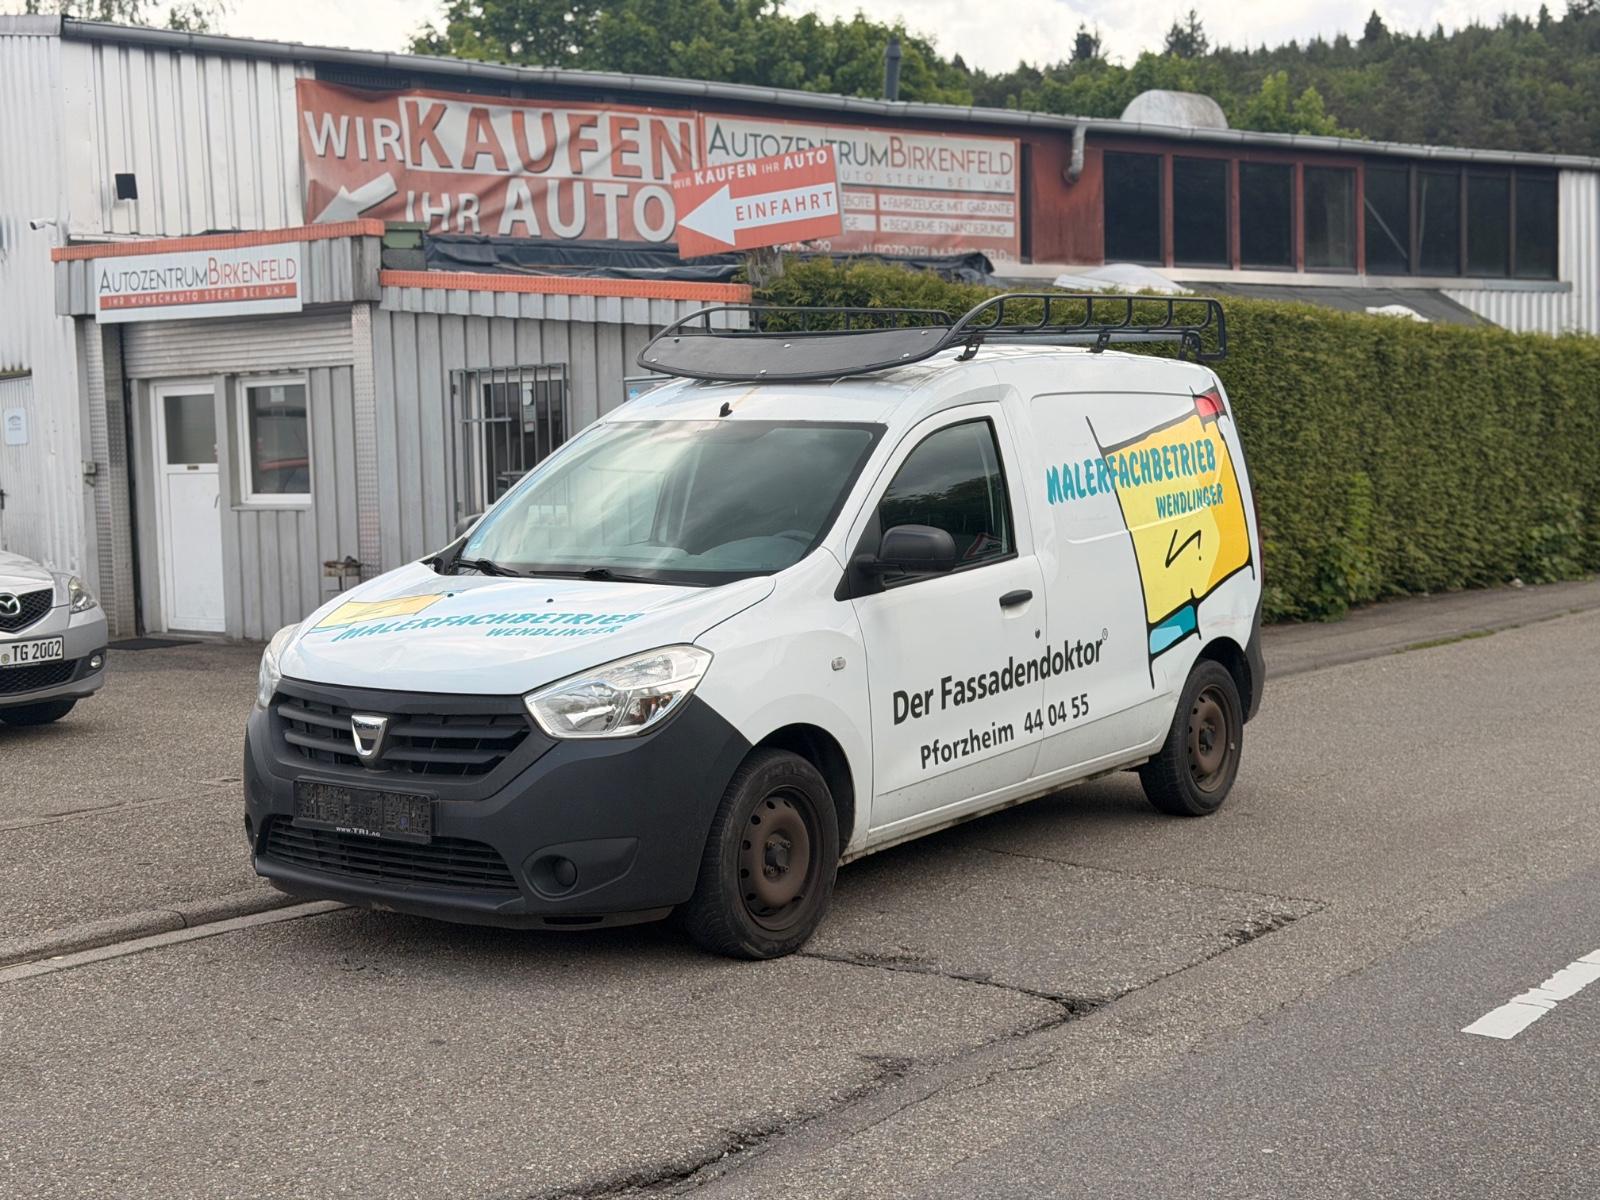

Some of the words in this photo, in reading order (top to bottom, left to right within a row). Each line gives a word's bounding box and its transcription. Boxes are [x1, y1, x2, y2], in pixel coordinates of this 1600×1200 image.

[304, 111, 404, 162] WIR
[404, 100, 692, 180] KAUFEN
[708, 122, 1013, 175] AUTOZERUMBIRKENFELD
[673, 177, 692, 190] WIR
[694, 163, 757, 186] KAUFEN
[762, 162, 780, 175] IHR
[783, 149, 828, 170] AUTO
[406, 190, 481, 234] IHR
[498, 179, 677, 242] AUTO
[735, 191, 833, 222] EINFAHRT
[131, 291, 199, 305] WUNSCHAUTO
[266, 285, 287, 297] UNS
[1046, 438, 1216, 505] MALERFACHBETRIEB
[1155, 483, 1224, 519] WENDLINGER
[331, 612, 645, 643] MALERFACHBETRIEB
[485, 625, 623, 637] WENDLINGER
[12, 645, 29, 661] TG
[32, 640, 61, 660] 2002
[893, 688, 934, 725] Der
[920, 721, 1015, 769] Pforzheim
[1024, 709, 1044, 734] 44
[1048, 700, 1067, 726] 04
[1071, 693, 1090, 719] 55
